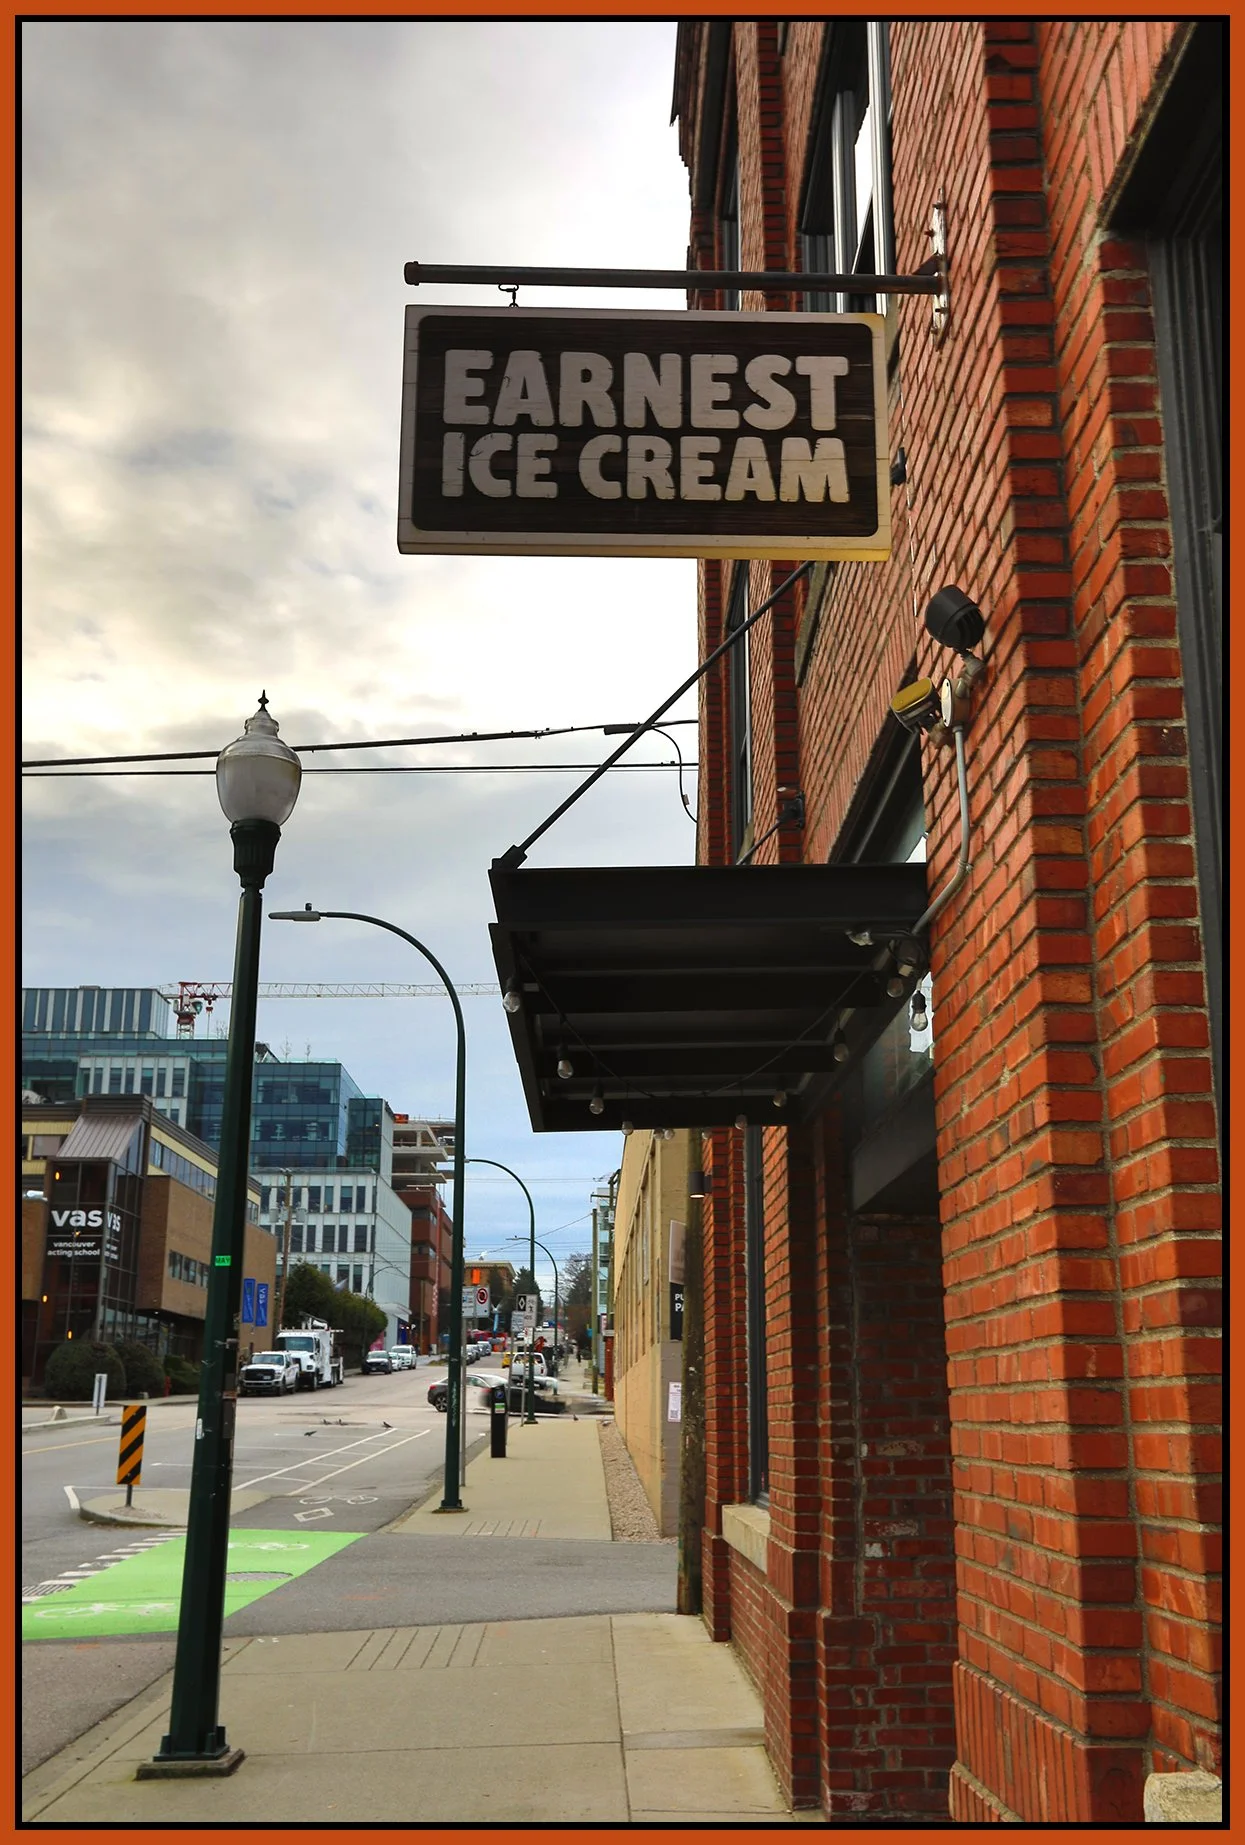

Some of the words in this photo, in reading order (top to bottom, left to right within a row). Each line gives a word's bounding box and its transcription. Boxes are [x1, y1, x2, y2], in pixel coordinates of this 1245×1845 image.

[442, 349, 850, 431] EARNEST
[442, 432, 558, 498] ICE
[578, 434, 850, 503] CREAM
[51, 1209, 103, 1228] vas
[47, 1249, 73, 1258] acting
